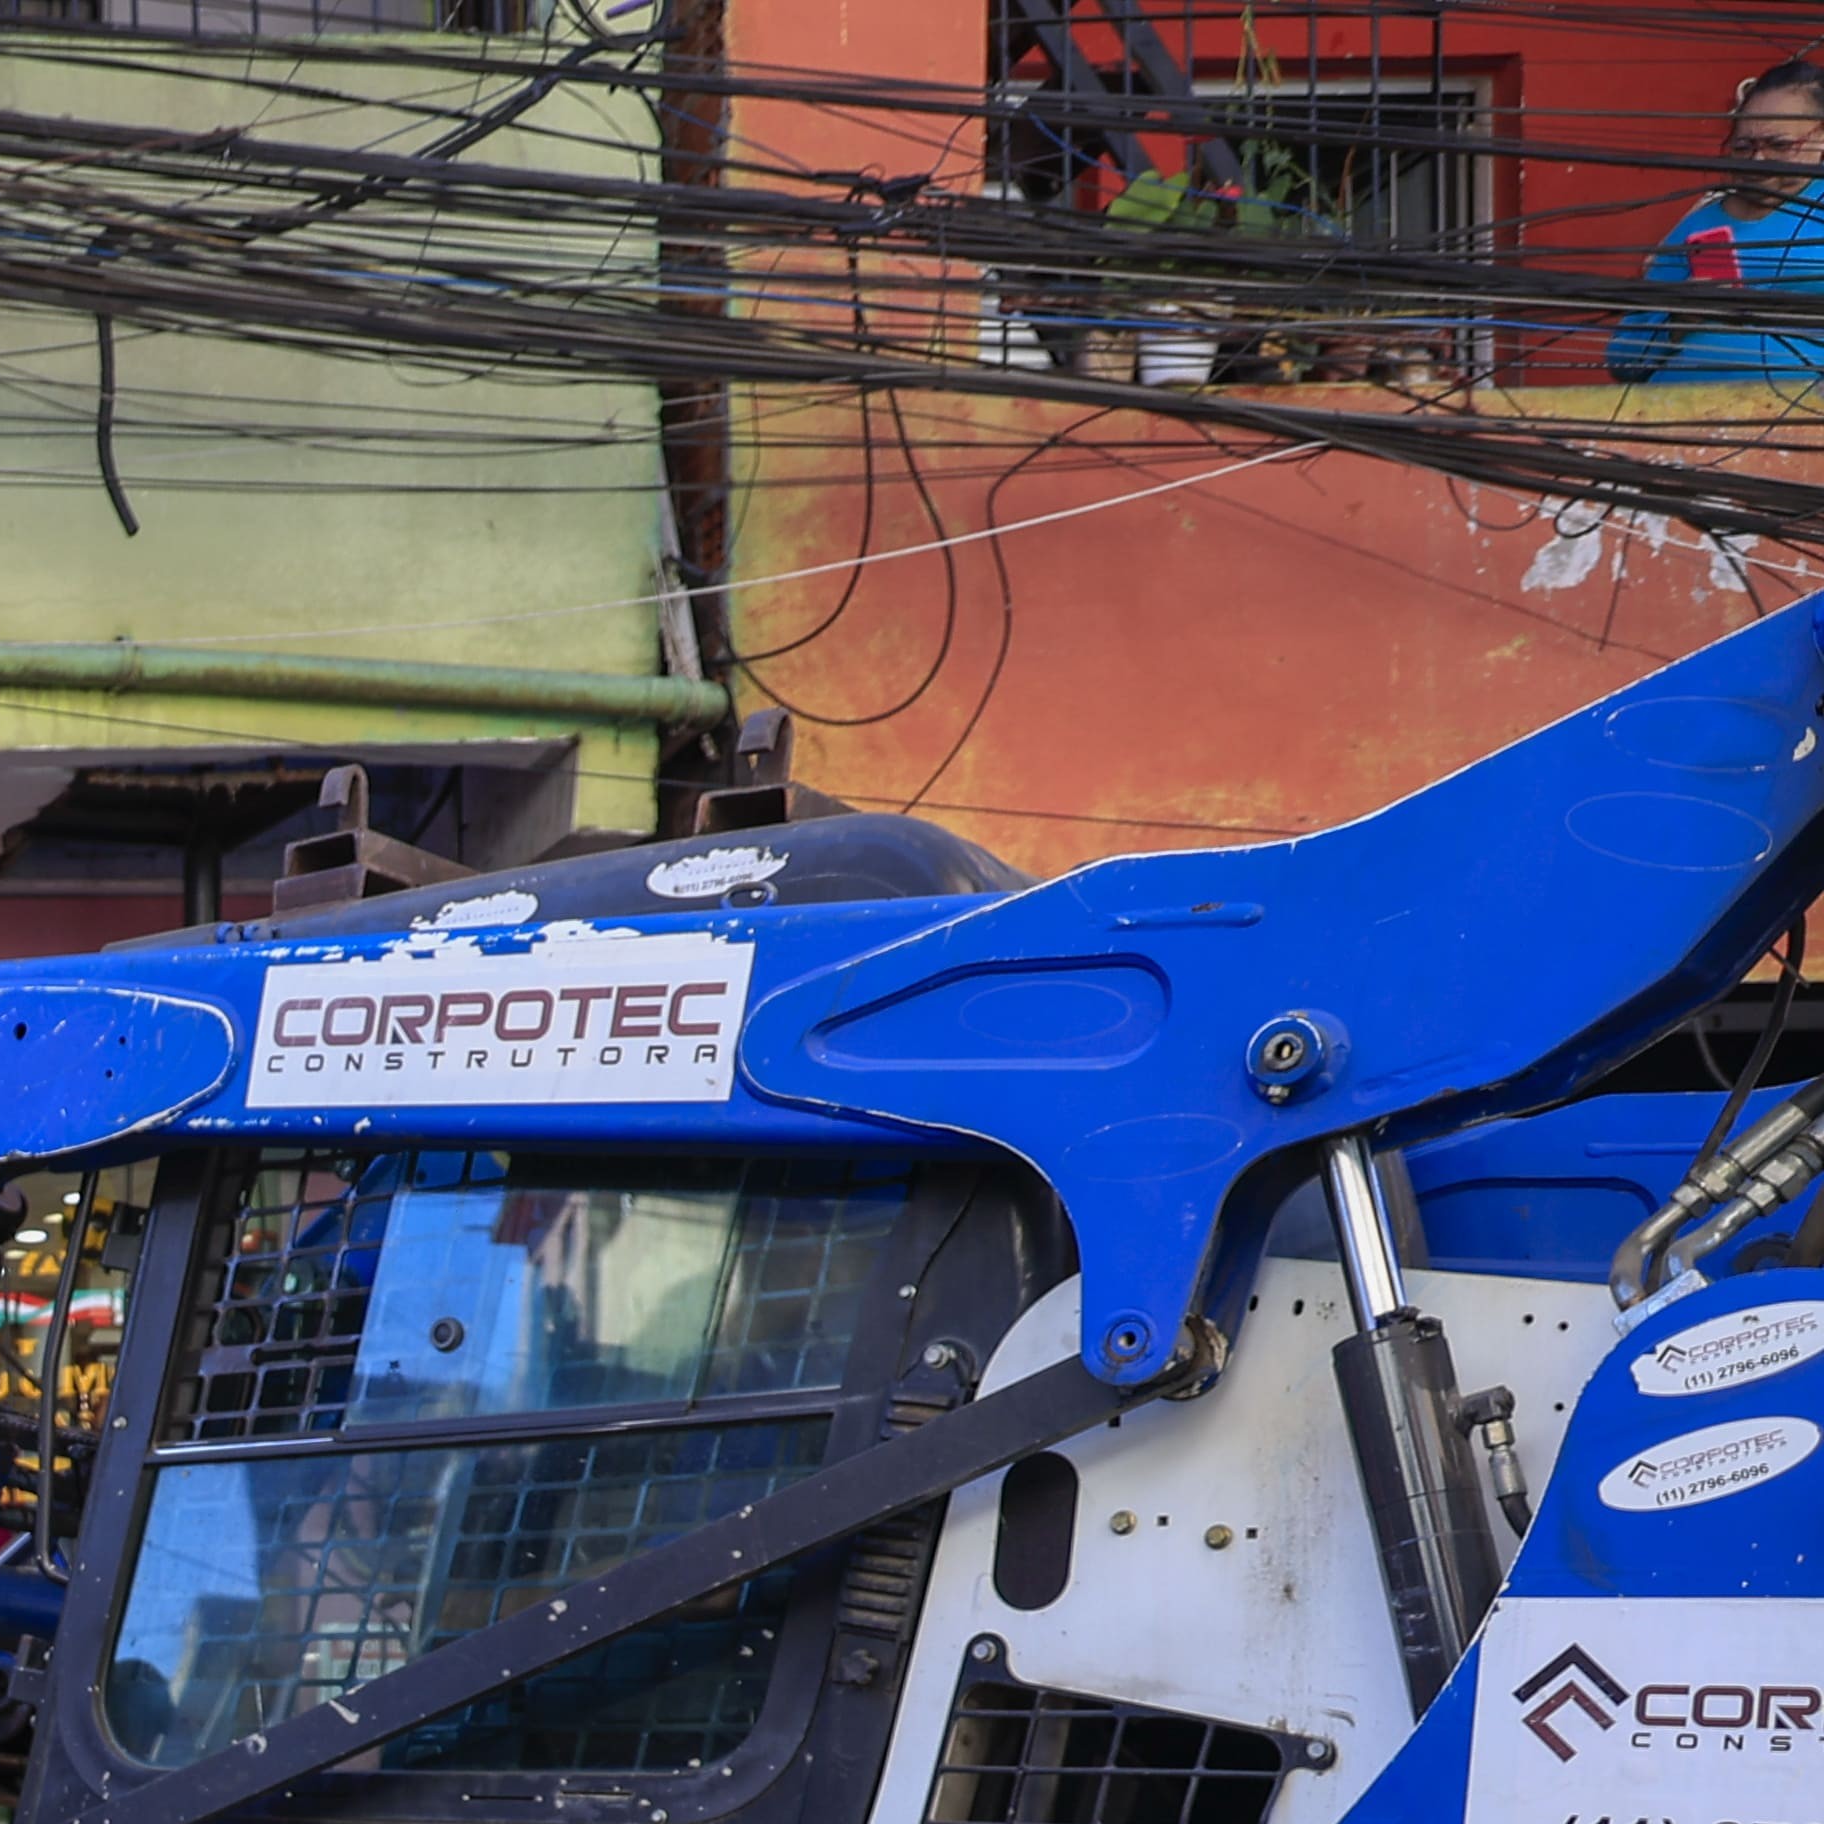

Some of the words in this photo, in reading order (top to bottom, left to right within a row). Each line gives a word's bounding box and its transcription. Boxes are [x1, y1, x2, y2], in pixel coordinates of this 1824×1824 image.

[273, 981, 728, 1048] CORPOTEC
[267, 1044, 718, 1073] CONSTRUTORA
[1688, 1312, 1817, 1360] CORPOTEC
[1684, 1372, 1715, 1391] (11)
[1718, 1344, 1800, 1380] 2796-6096
[1659, 1429, 1784, 1475] CORPOTEC
[1656, 1487, 1685, 1506] (11)
[1688, 1462, 1770, 1497] 2796-6096
[1631, 1733, 1824, 1752] CONS
